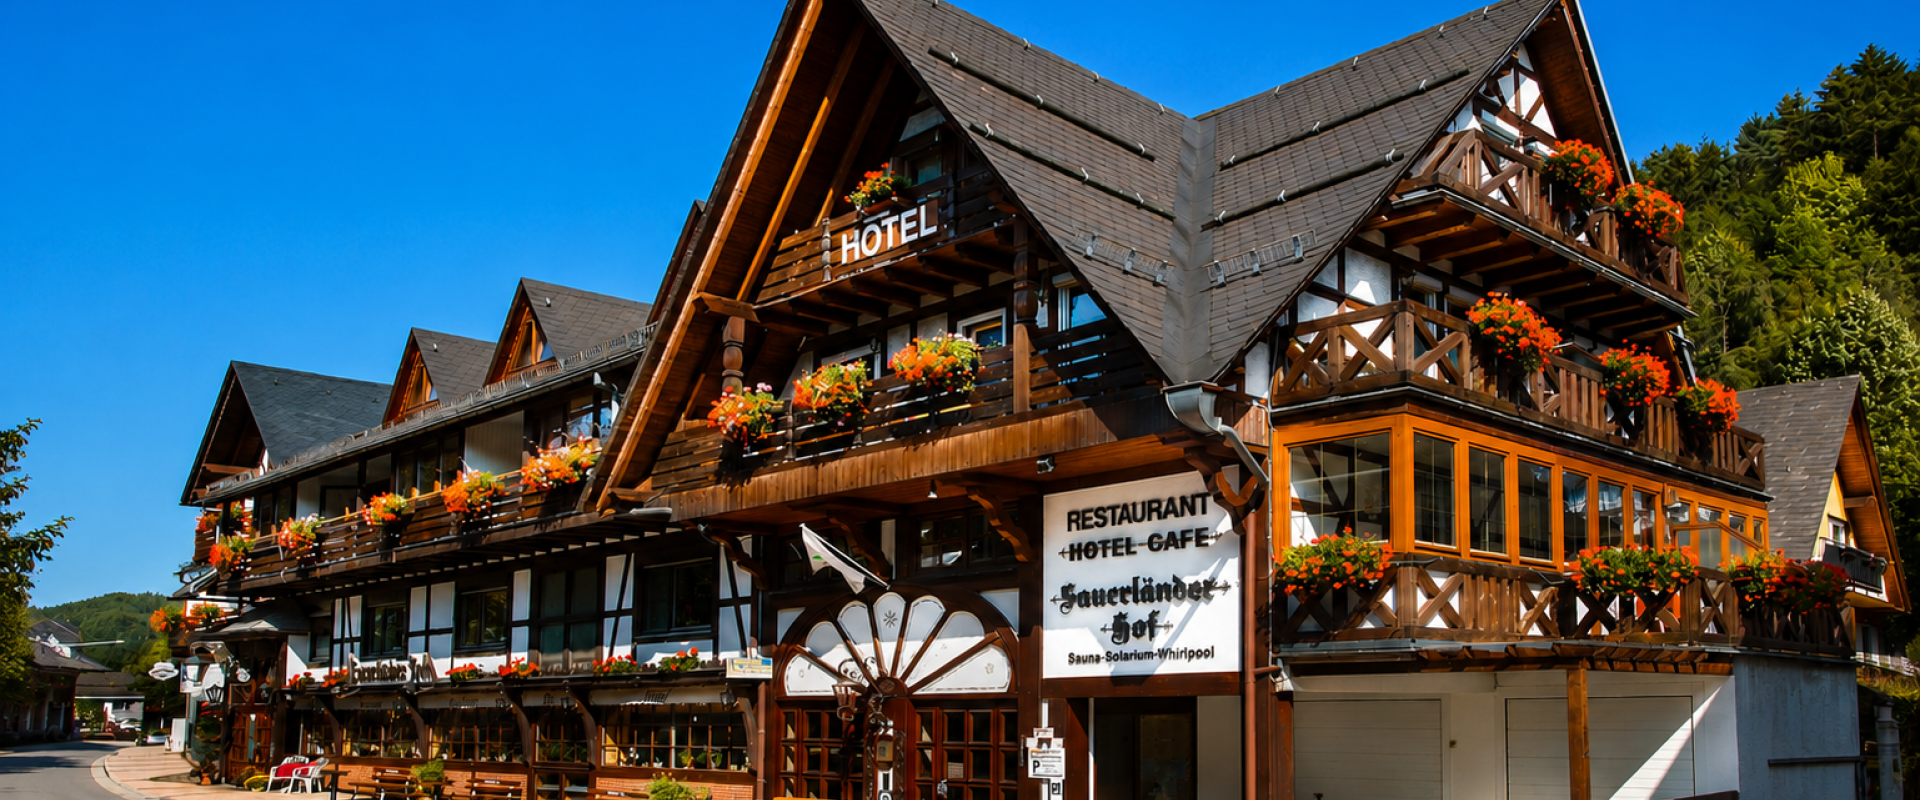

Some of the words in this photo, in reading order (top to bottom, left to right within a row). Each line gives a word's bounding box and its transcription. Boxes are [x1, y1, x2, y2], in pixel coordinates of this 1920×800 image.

[841, 203, 938, 265] HOTEL
[1067, 492, 1211, 532] RESTAURANT
[1060, 574, 1218, 615] Sauerländer
[1111, 609, 1161, 645] Hof
